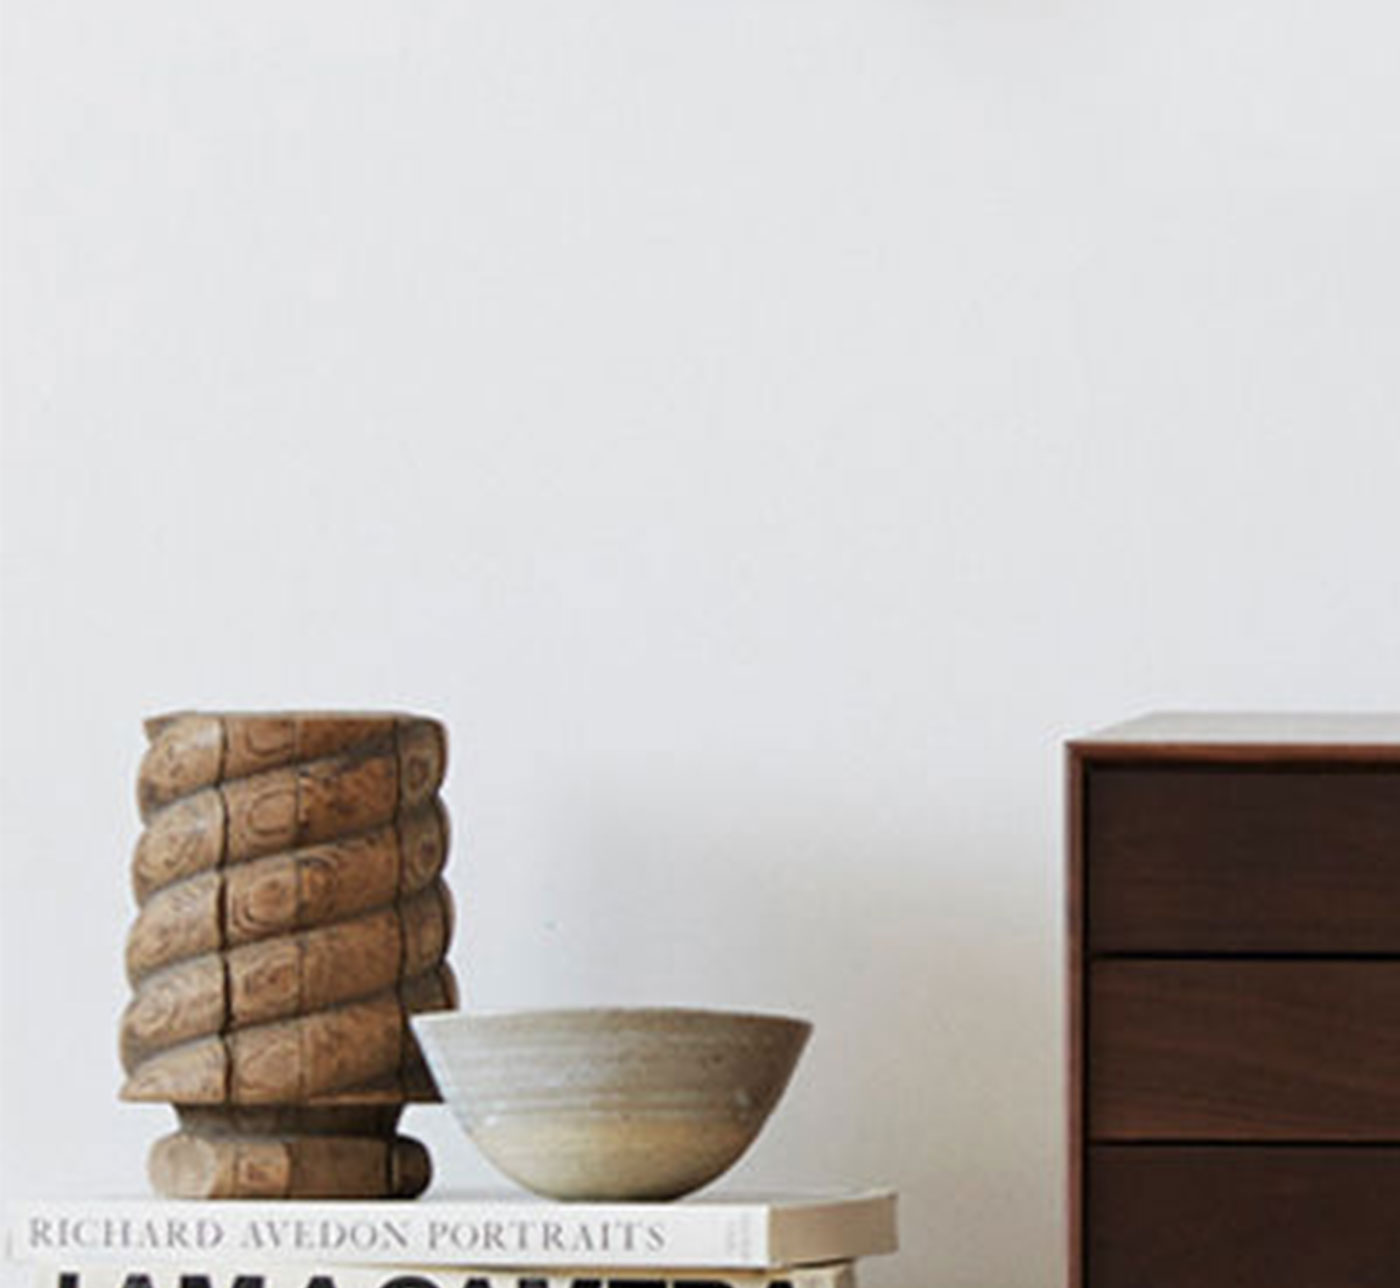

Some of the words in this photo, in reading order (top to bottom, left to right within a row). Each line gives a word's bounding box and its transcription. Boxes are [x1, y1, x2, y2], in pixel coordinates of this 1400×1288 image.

[29, 1218, 225, 1248] RICHARD
[240, 1220, 409, 1249] AVEDON
[428, 1221, 666, 1251] PORTRAITS
